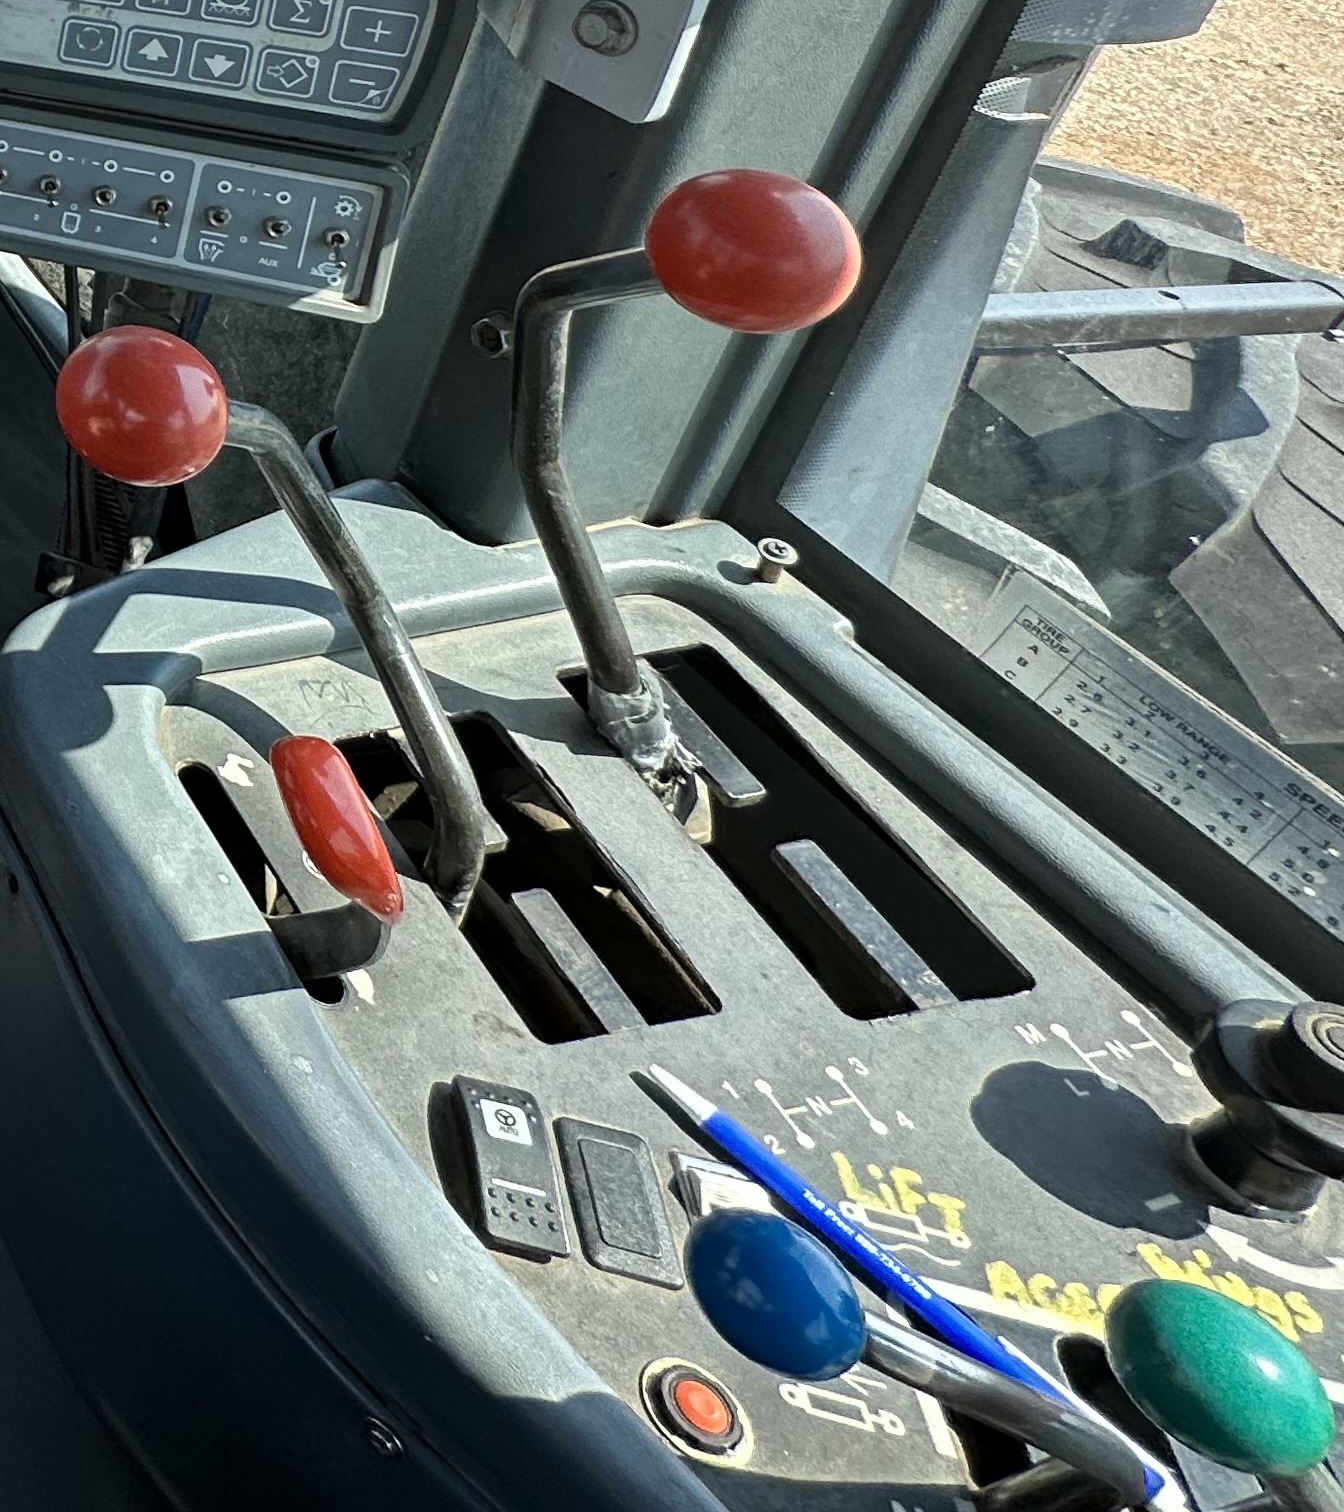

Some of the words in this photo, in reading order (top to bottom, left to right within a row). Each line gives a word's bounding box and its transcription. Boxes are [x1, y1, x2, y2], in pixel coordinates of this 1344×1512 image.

[258, 257, 279, 268] AUX
[1022, 618, 1070, 654] GROUP
[1036, 618, 1066, 643] TIRE
[1016, 656, 1029, 668] B
[1028, 645, 1039, 655] A
[1004, 669, 1017, 680] C
[1139, 695, 1175, 722] LOW
[1176, 722, 1232, 765] RANGE
[1284, 782, 1344, 833] SPEE
[1014, 1023, 1048, 1045] M
[1104, 1039, 1134, 1061] N
[721, 1079, 741, 1099] 1
[847, 1056, 870, 1077] 3
[1064, 1078, 1090, 1097] L
[805, 1095, 833, 1117] N
[763, 1134, 787, 1155] 2
[895, 1109, 916, 1130] 4
